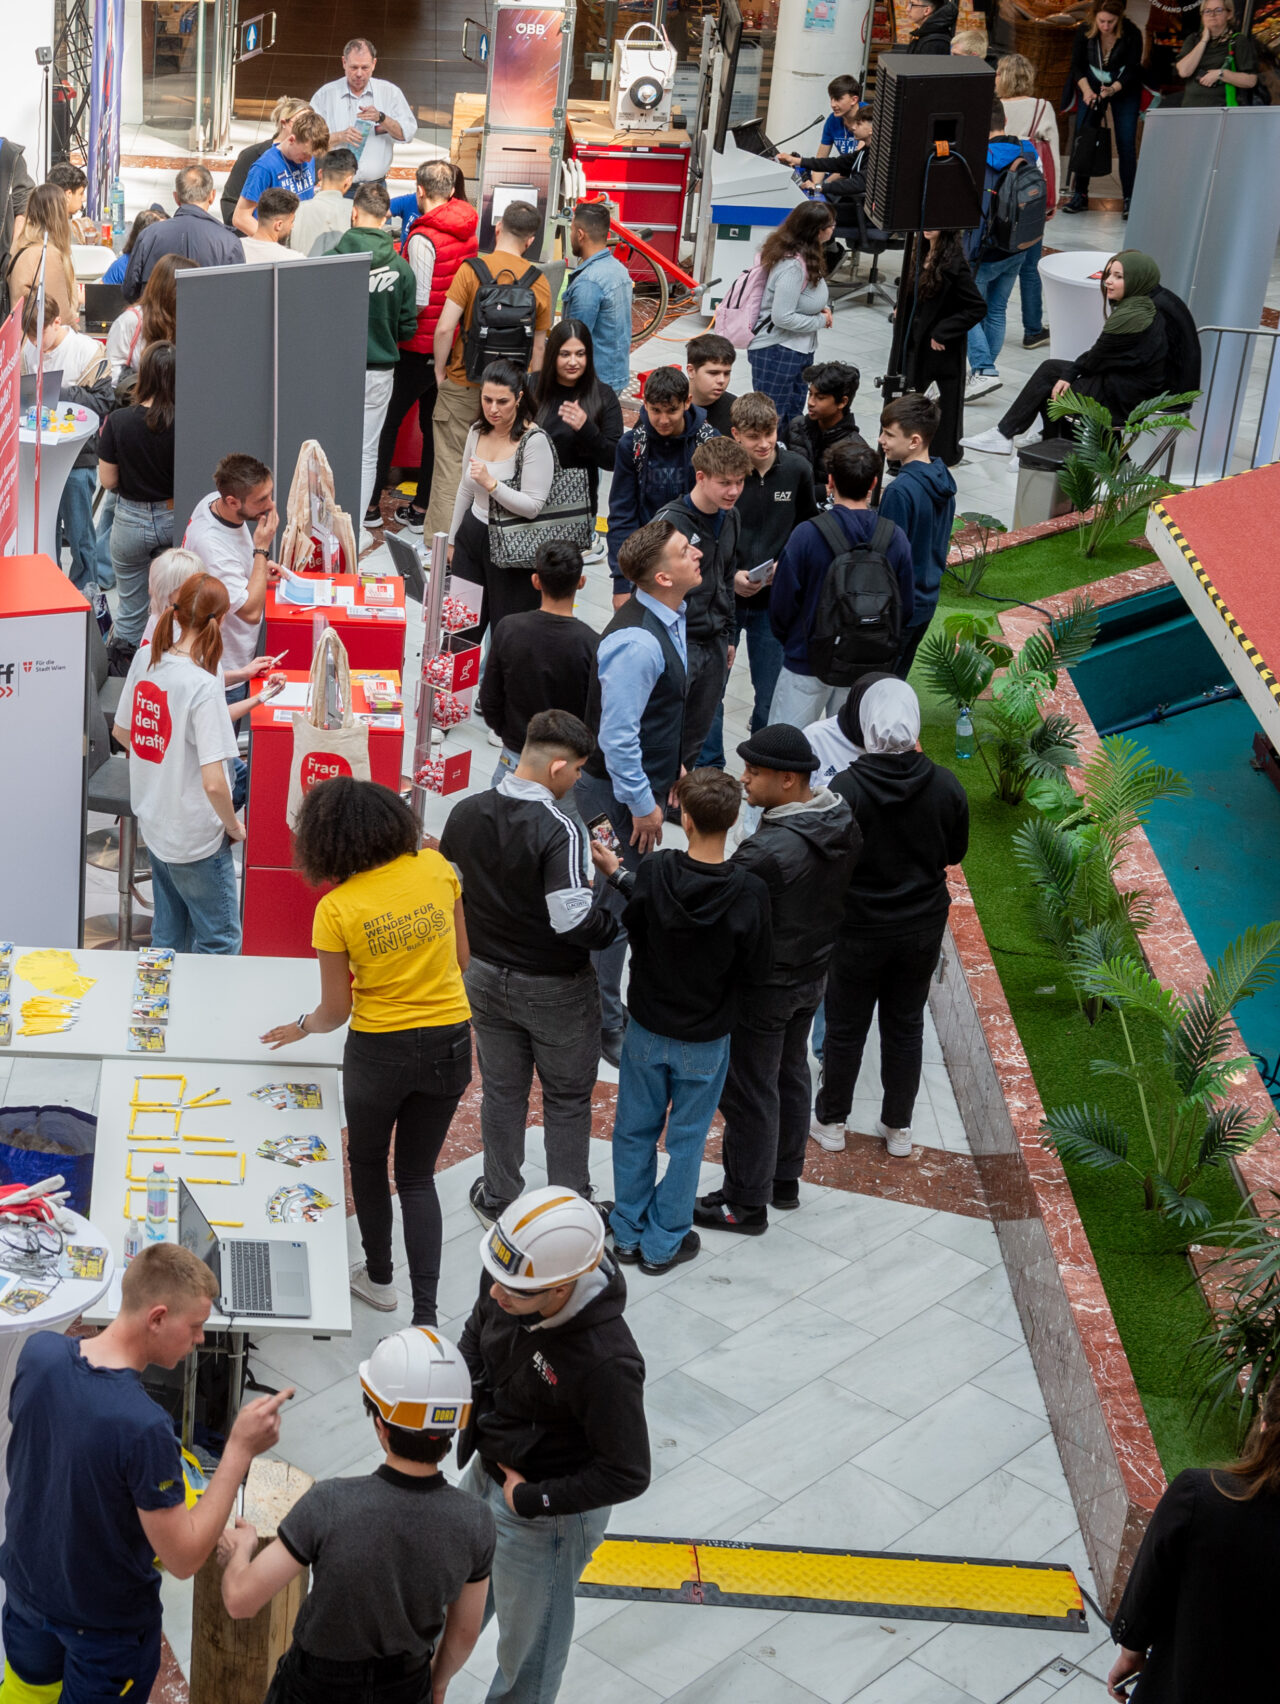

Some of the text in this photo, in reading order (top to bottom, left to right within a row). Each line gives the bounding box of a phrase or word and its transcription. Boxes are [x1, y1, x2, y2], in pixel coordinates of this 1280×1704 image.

[774, 491, 792, 500] EA7
[136, 690, 161, 719] Frag
[135, 710, 159, 732] den
[134, 732, 165, 755] waff!
[307, 757, 340, 778] Frag
[363, 912, 393, 930] BITTE
[365, 902, 435, 938] WENDEN FÜR
[368, 909, 446, 956] INFOS
[406, 938, 426, 951] BUILT
[427, 935, 437, 943] BY
